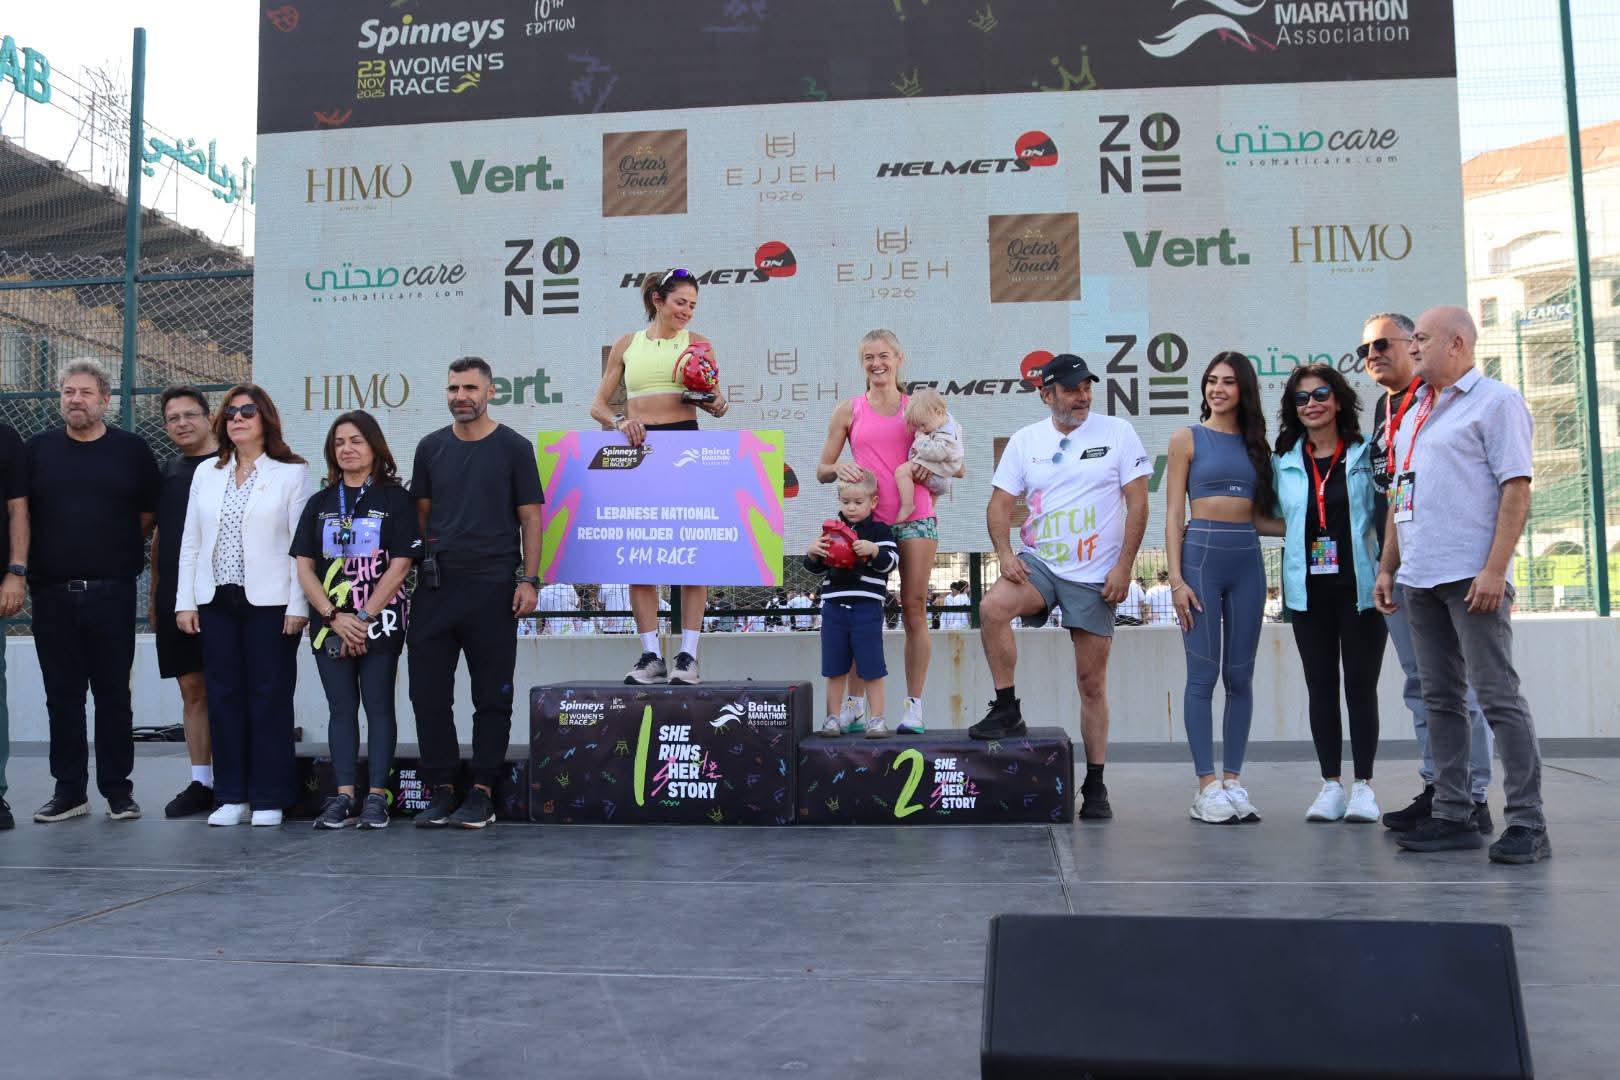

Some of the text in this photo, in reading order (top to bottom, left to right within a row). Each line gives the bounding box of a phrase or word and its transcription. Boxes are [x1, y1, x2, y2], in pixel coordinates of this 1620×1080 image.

[1274, 0, 1409, 24] MARATHON
[358, 14, 505, 54] Spinneys
[526, 16, 576, 36] EDITION
[1276, 22, 1410, 45] Association
[357, 60, 386, 78] 23
[389, 52, 504, 76] WOMEN'S
[357, 77, 385, 89] NOV
[390, 76, 449, 96] RACE
[357, 89, 385, 99] 2025
[1327, 128, 1399, 150] care
[1020, 148, 1045, 157] ON
[450, 155, 564, 194] Vert.
[726, 163, 836, 186] EJJEH
[876, 158, 1031, 177] HELMETS
[305, 163, 413, 203] HIMO
[617, 170, 669, 188] Touch
[759, 190, 803, 202] 1926
[1123, 228, 1250, 268] Vert.
[1289, 223, 1413, 263] HIMO
[760, 258, 785, 268] ON
[836, 260, 949, 282] EJJEH
[1006, 255, 1060, 272] Touch
[402, 263, 467, 286] care
[870, 287, 916, 298] 1926
[303, 373, 410, 411] HIMO
[489, 368, 563, 405] ert.
[727, 382, 840, 404] EJJEH
[903, 379, 1038, 396] ELMETS
[760, 409, 806, 420] 1926
[602, 447, 638, 456] Spinneys
[701, 448, 730, 456] Beirut
[596, 506, 719, 520] LEBANESE NATIONAL
[577, 526, 739, 542] RECORD HOLDER (WOMEN)
[629, 547, 652, 565] KM
[657, 547, 698, 565] RACE
[560, 700, 605, 712] Spinneys
[748, 701, 786, 711] Beirut
[659, 725, 691, 742] SHE
[659, 744, 701, 761] RUNS
[669, 763, 700, 780] HER
[934, 759, 957, 770] SHE
[400, 770, 416, 779] SHE
[934, 771, 964, 783] RUNS
[400, 780, 422, 789] RUNS
[668, 782, 717, 799] STORY
[893, 749, 925, 818] 2
[942, 785, 964, 795] HER
[404, 790, 421, 799] HER
[942, 797, 976, 809] STORY
[405, 800, 431, 809] STORY
